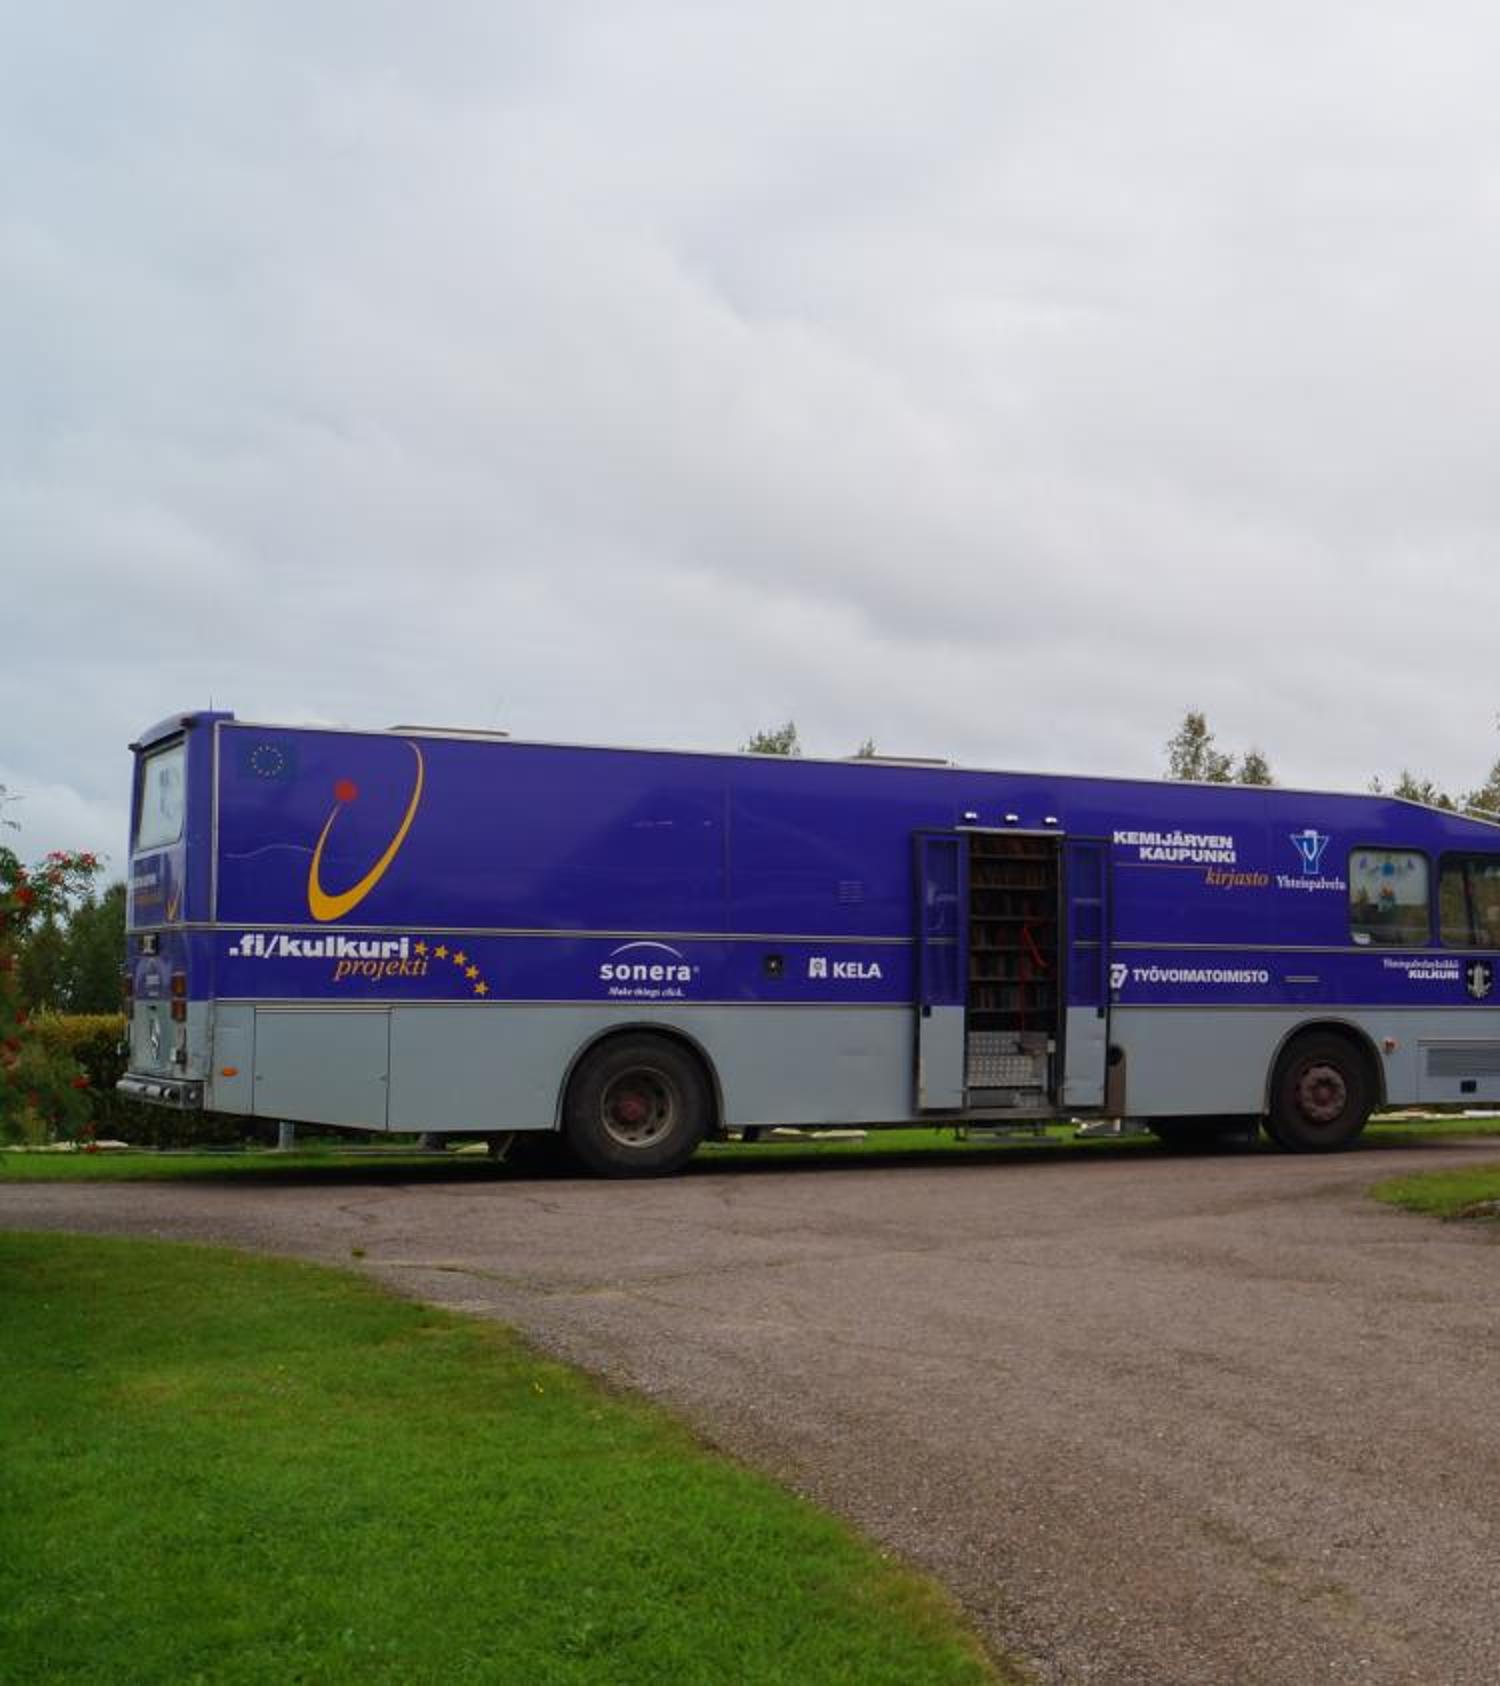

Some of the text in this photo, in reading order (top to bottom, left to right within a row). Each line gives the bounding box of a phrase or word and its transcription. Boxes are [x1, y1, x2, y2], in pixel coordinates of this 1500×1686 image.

[1112, 830, 1234, 849] KEMIJÄRVEN
[1139, 847, 1237, 863] KAUPUNKI
[1205, 867, 1270, 890] kirjasto
[333, 956, 429, 982] projekti
[599, 963, 691, 982] sonera
[833, 962, 883, 979] KELA
[1132, 965, 1269, 983] TYÖVOIMATOIMISTO
[1408, 969, 1459, 979] KULKURI
